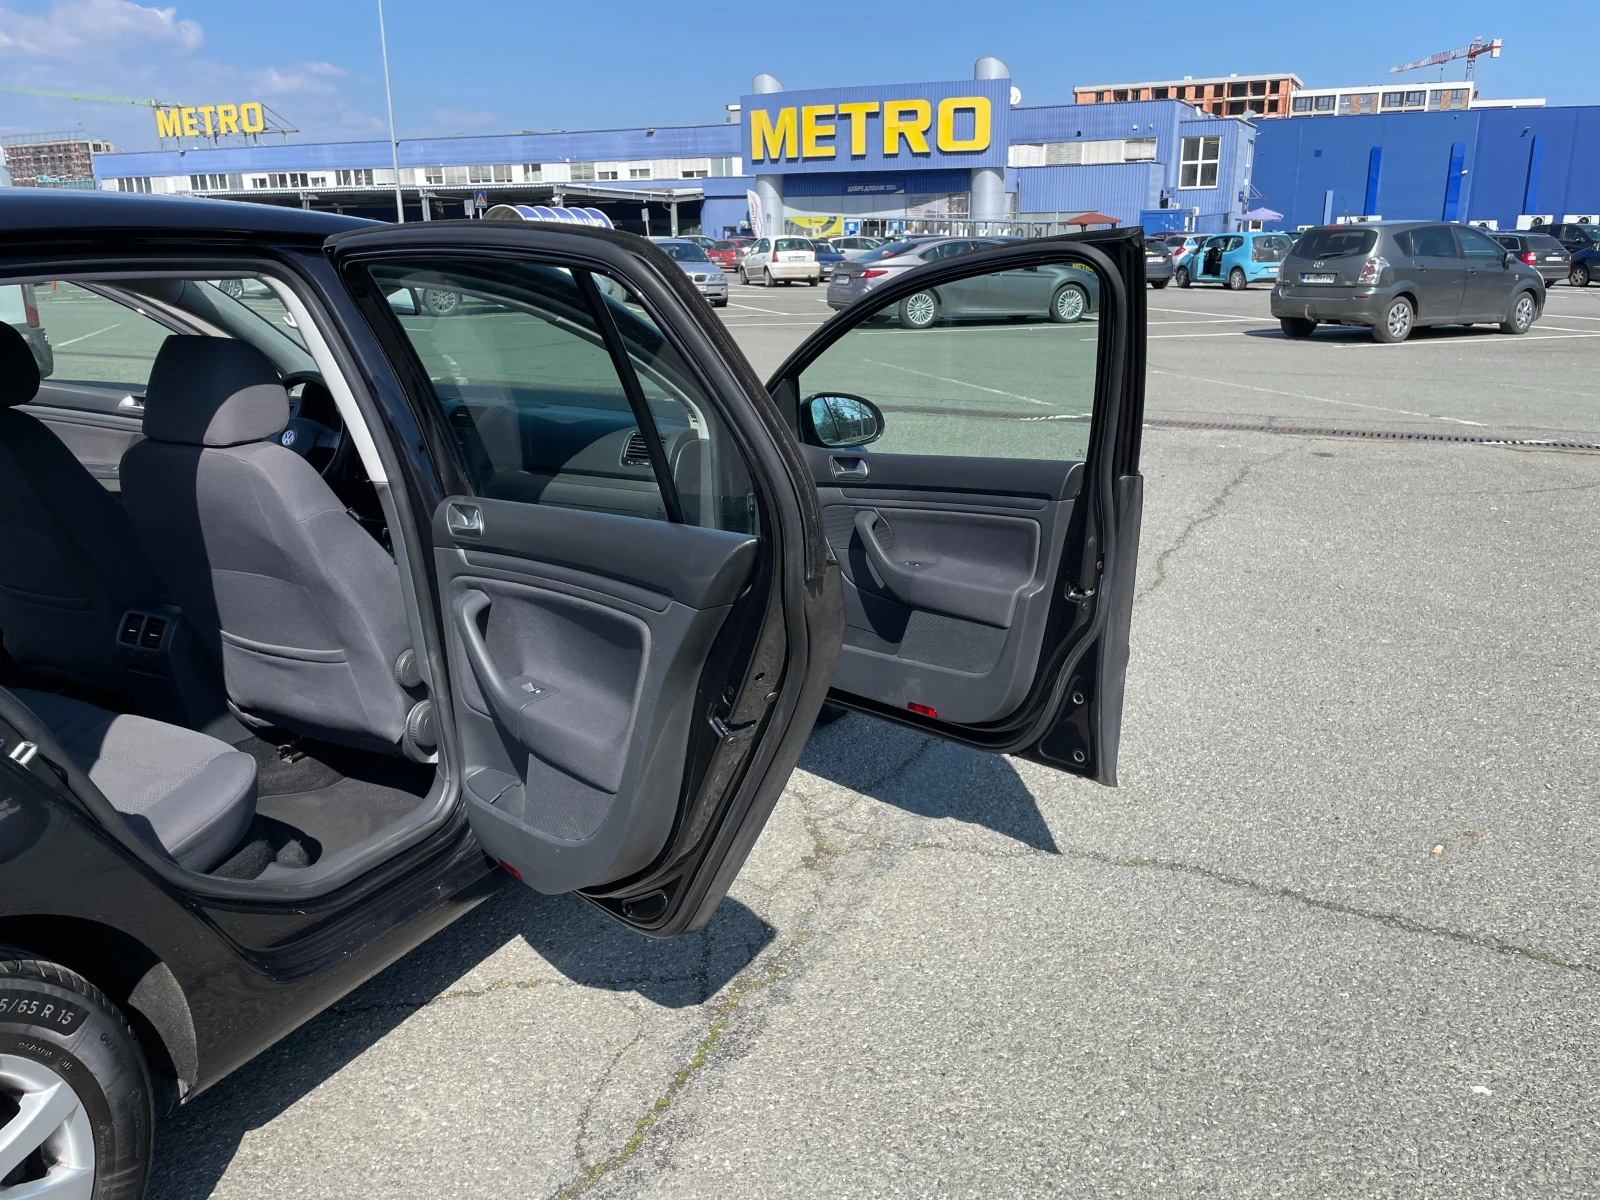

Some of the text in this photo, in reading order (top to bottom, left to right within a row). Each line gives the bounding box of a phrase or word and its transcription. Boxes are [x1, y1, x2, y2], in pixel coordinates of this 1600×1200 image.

[156, 102, 263, 137] METRO
[751, 97, 991, 160] METRO
[40, 1003, 55, 1018] R
[56, 1009, 74, 1025] 15
